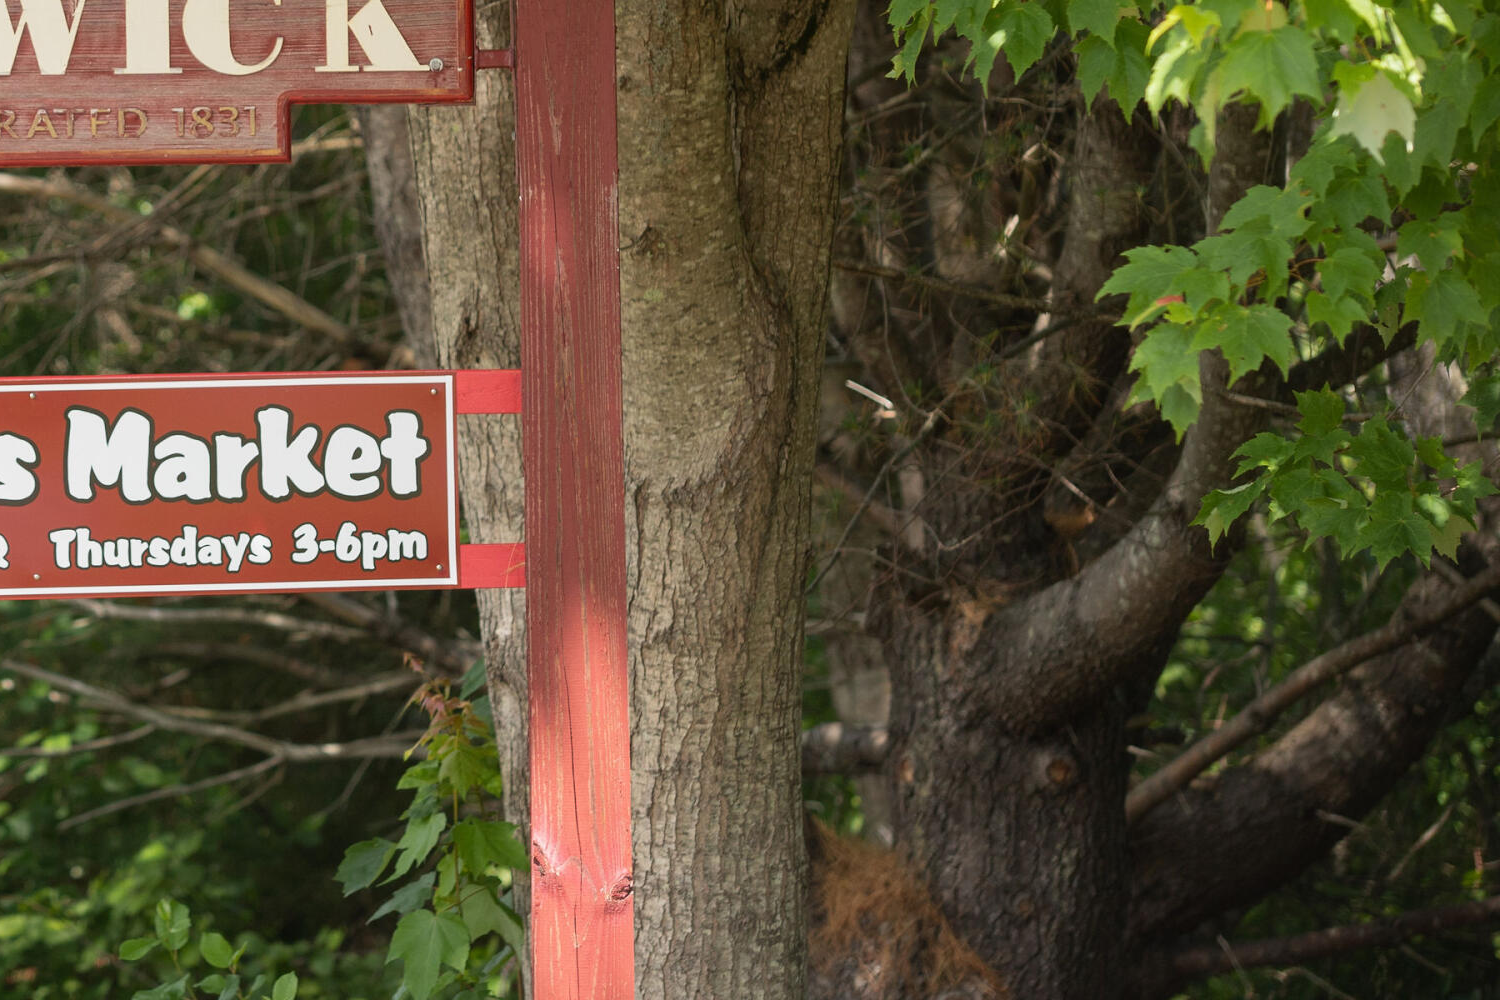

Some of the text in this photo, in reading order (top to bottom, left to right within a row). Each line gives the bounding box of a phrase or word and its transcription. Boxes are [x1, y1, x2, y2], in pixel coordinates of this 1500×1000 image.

[171, 105, 258, 140] 1831
[63, 404, 431, 506] Market
[49, 522, 430, 573] Thursdays 3-6pm
